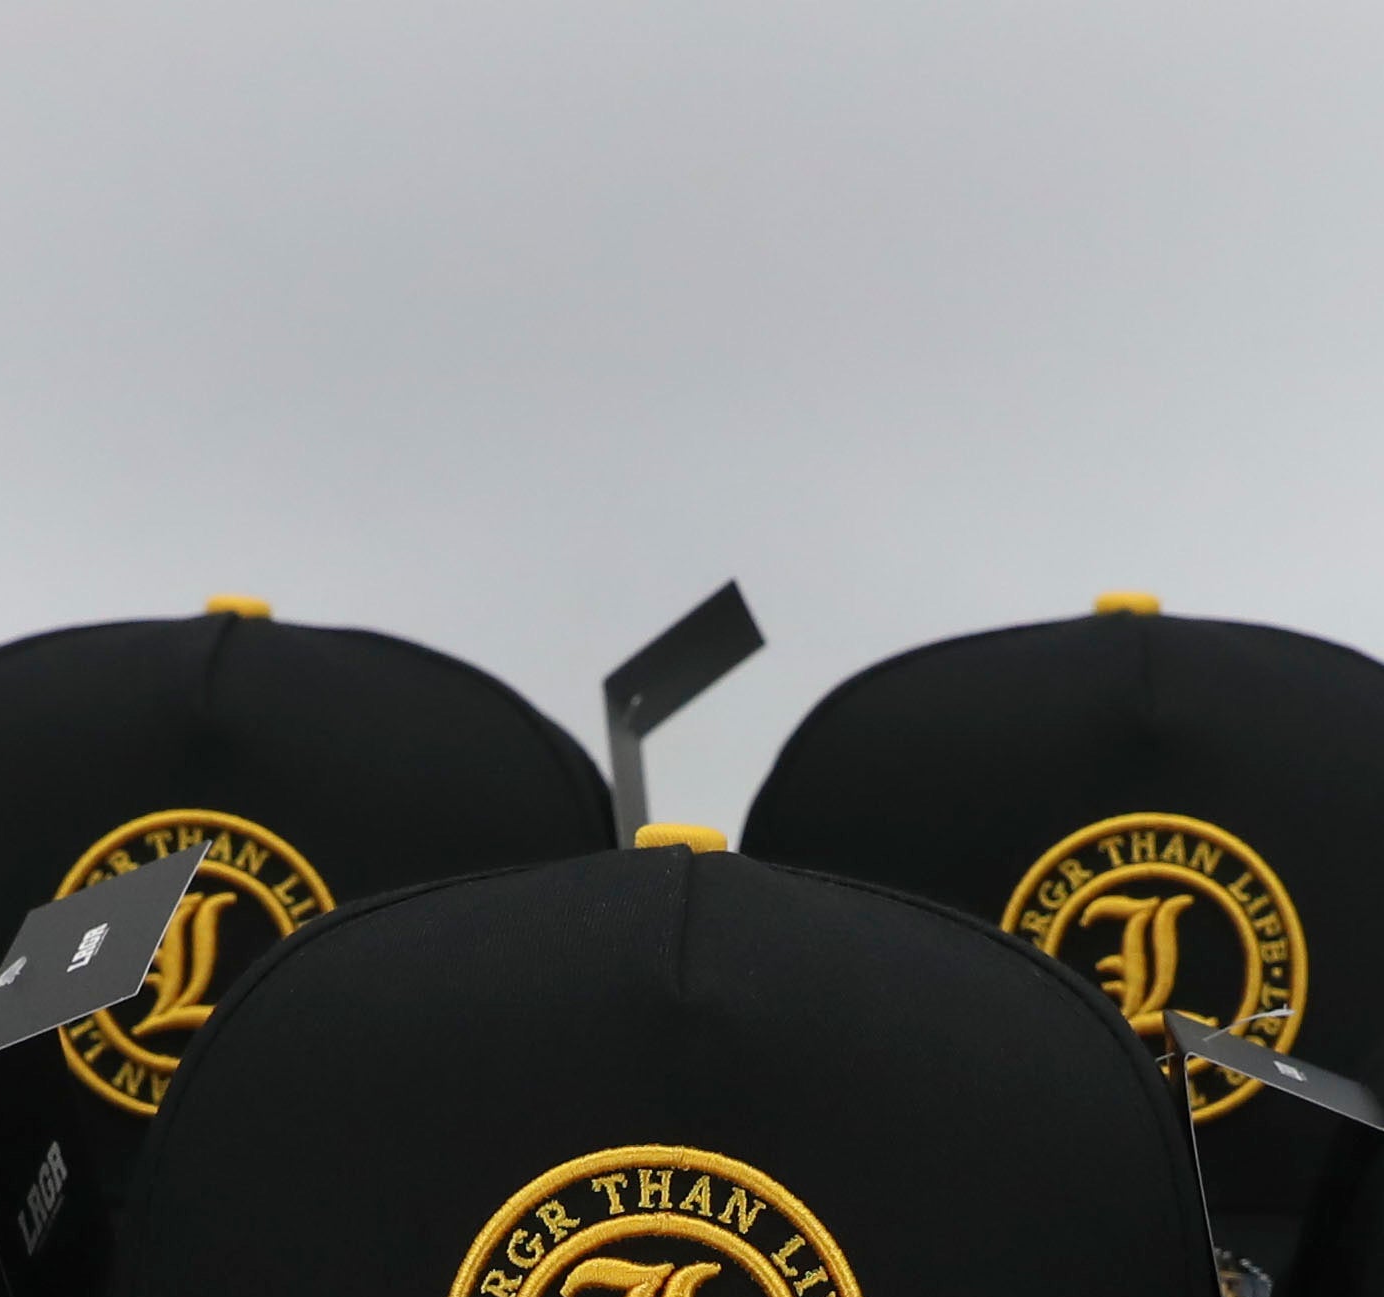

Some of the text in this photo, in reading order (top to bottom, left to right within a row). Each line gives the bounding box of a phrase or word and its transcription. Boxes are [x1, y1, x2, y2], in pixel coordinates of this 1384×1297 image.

[1020, 831, 1289, 962] RGR THAN LIFE
[1079, 894, 1219, 1034] L
[18, 1140, 68, 1256] LRGR
[591, 1168, 767, 1235] THAN
